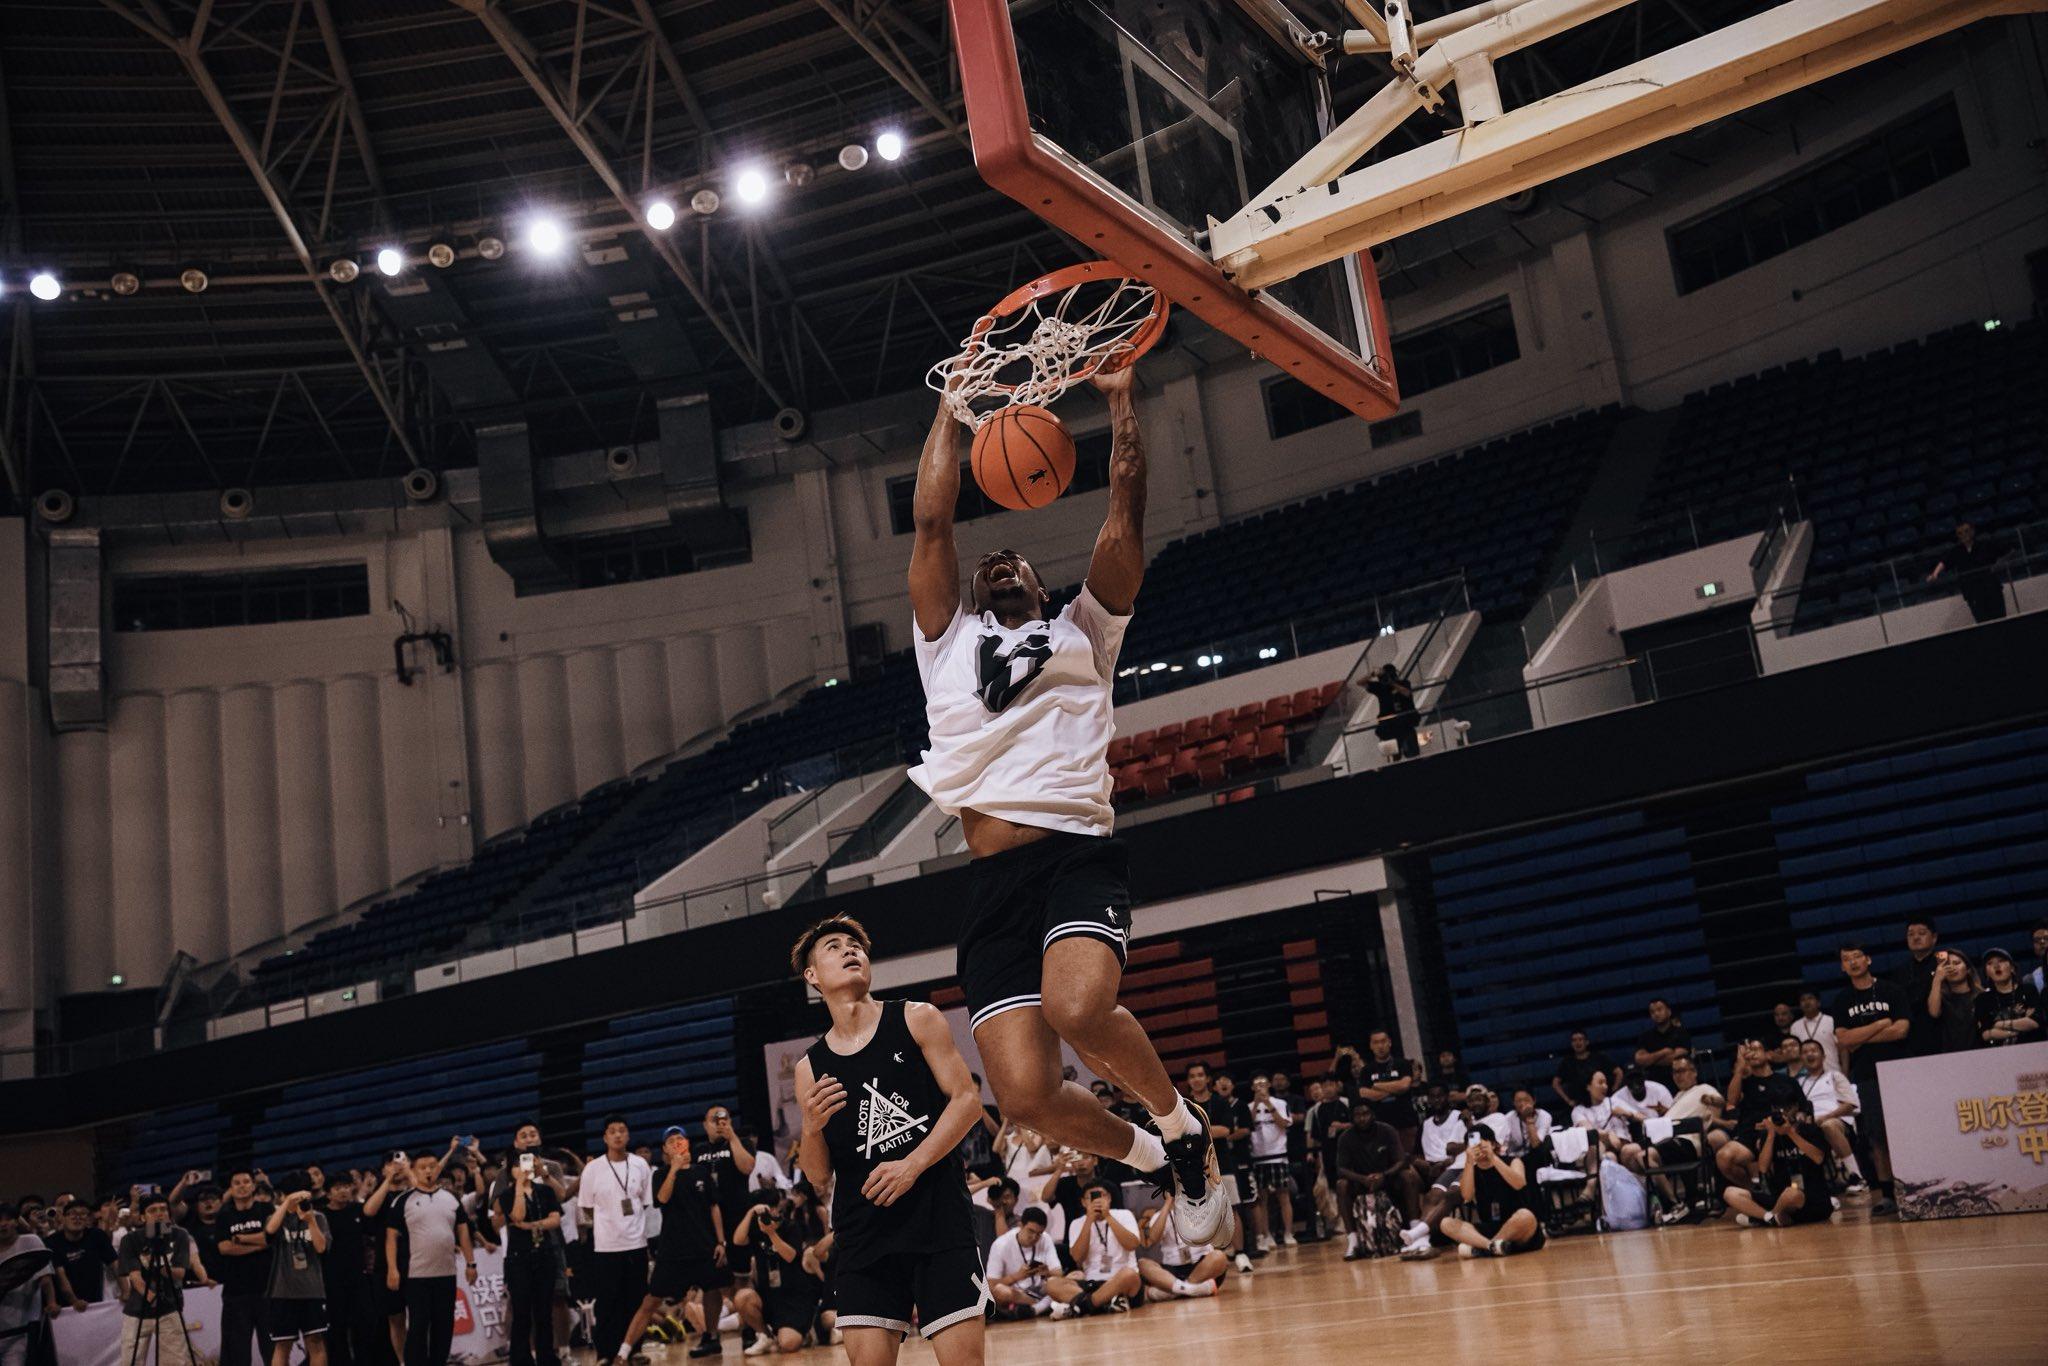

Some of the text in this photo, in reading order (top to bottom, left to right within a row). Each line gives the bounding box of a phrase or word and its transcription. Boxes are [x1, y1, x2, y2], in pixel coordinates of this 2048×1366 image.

[858, 1100, 870, 1135] ROOTS
[890, 1092, 910, 1111] FOR
[1957, 1090, 2048, 1134] 凯尔登
[879, 1131, 913, 1153] BATTLE
[2018, 1126, 2048, 1164] 中
